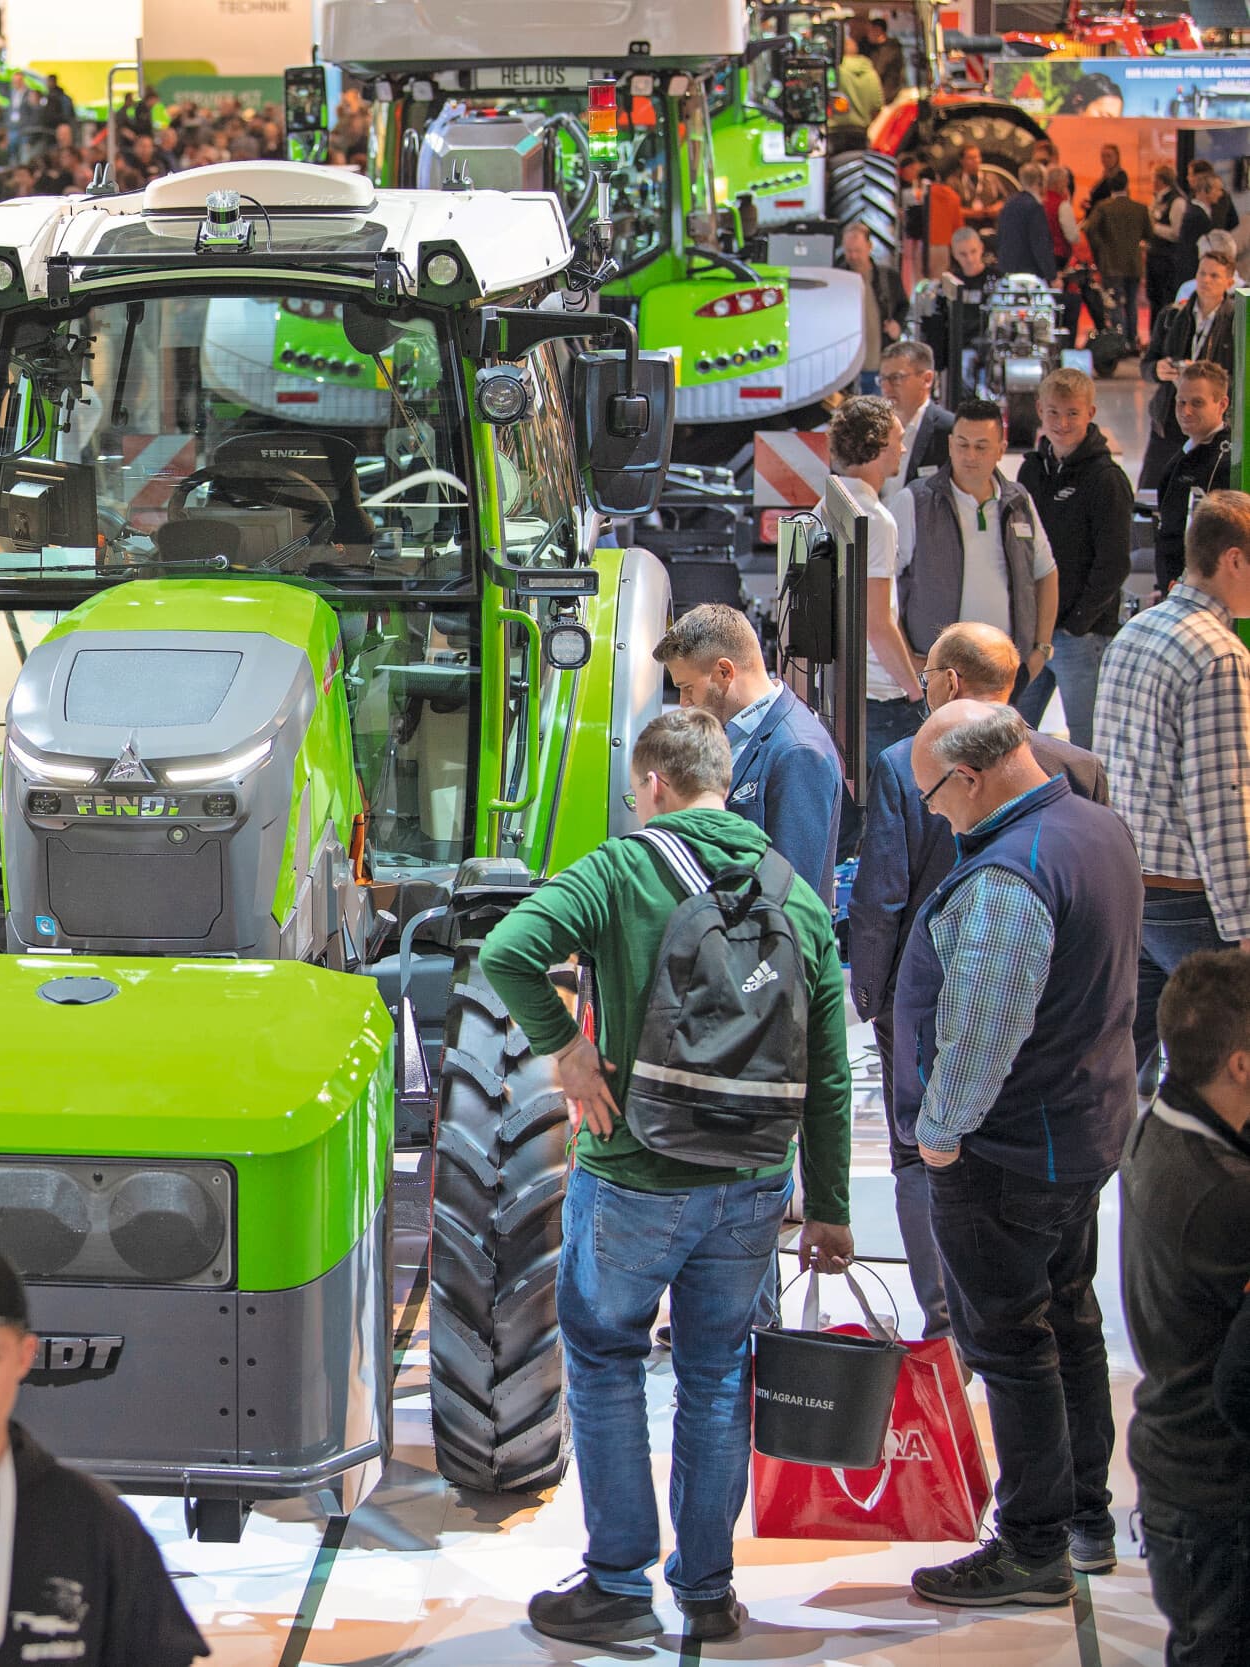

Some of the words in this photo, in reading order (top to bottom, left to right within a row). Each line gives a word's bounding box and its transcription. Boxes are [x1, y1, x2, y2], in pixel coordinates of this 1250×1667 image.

[501, 64, 566, 86] HELIOS
[260, 448, 309, 459] FENDT
[74, 794, 188, 818] FENDT
[741, 970, 779, 993] adidas
[772, 1391, 803, 1406] AGRAR
[805, 1398, 835, 1410] LEASE
